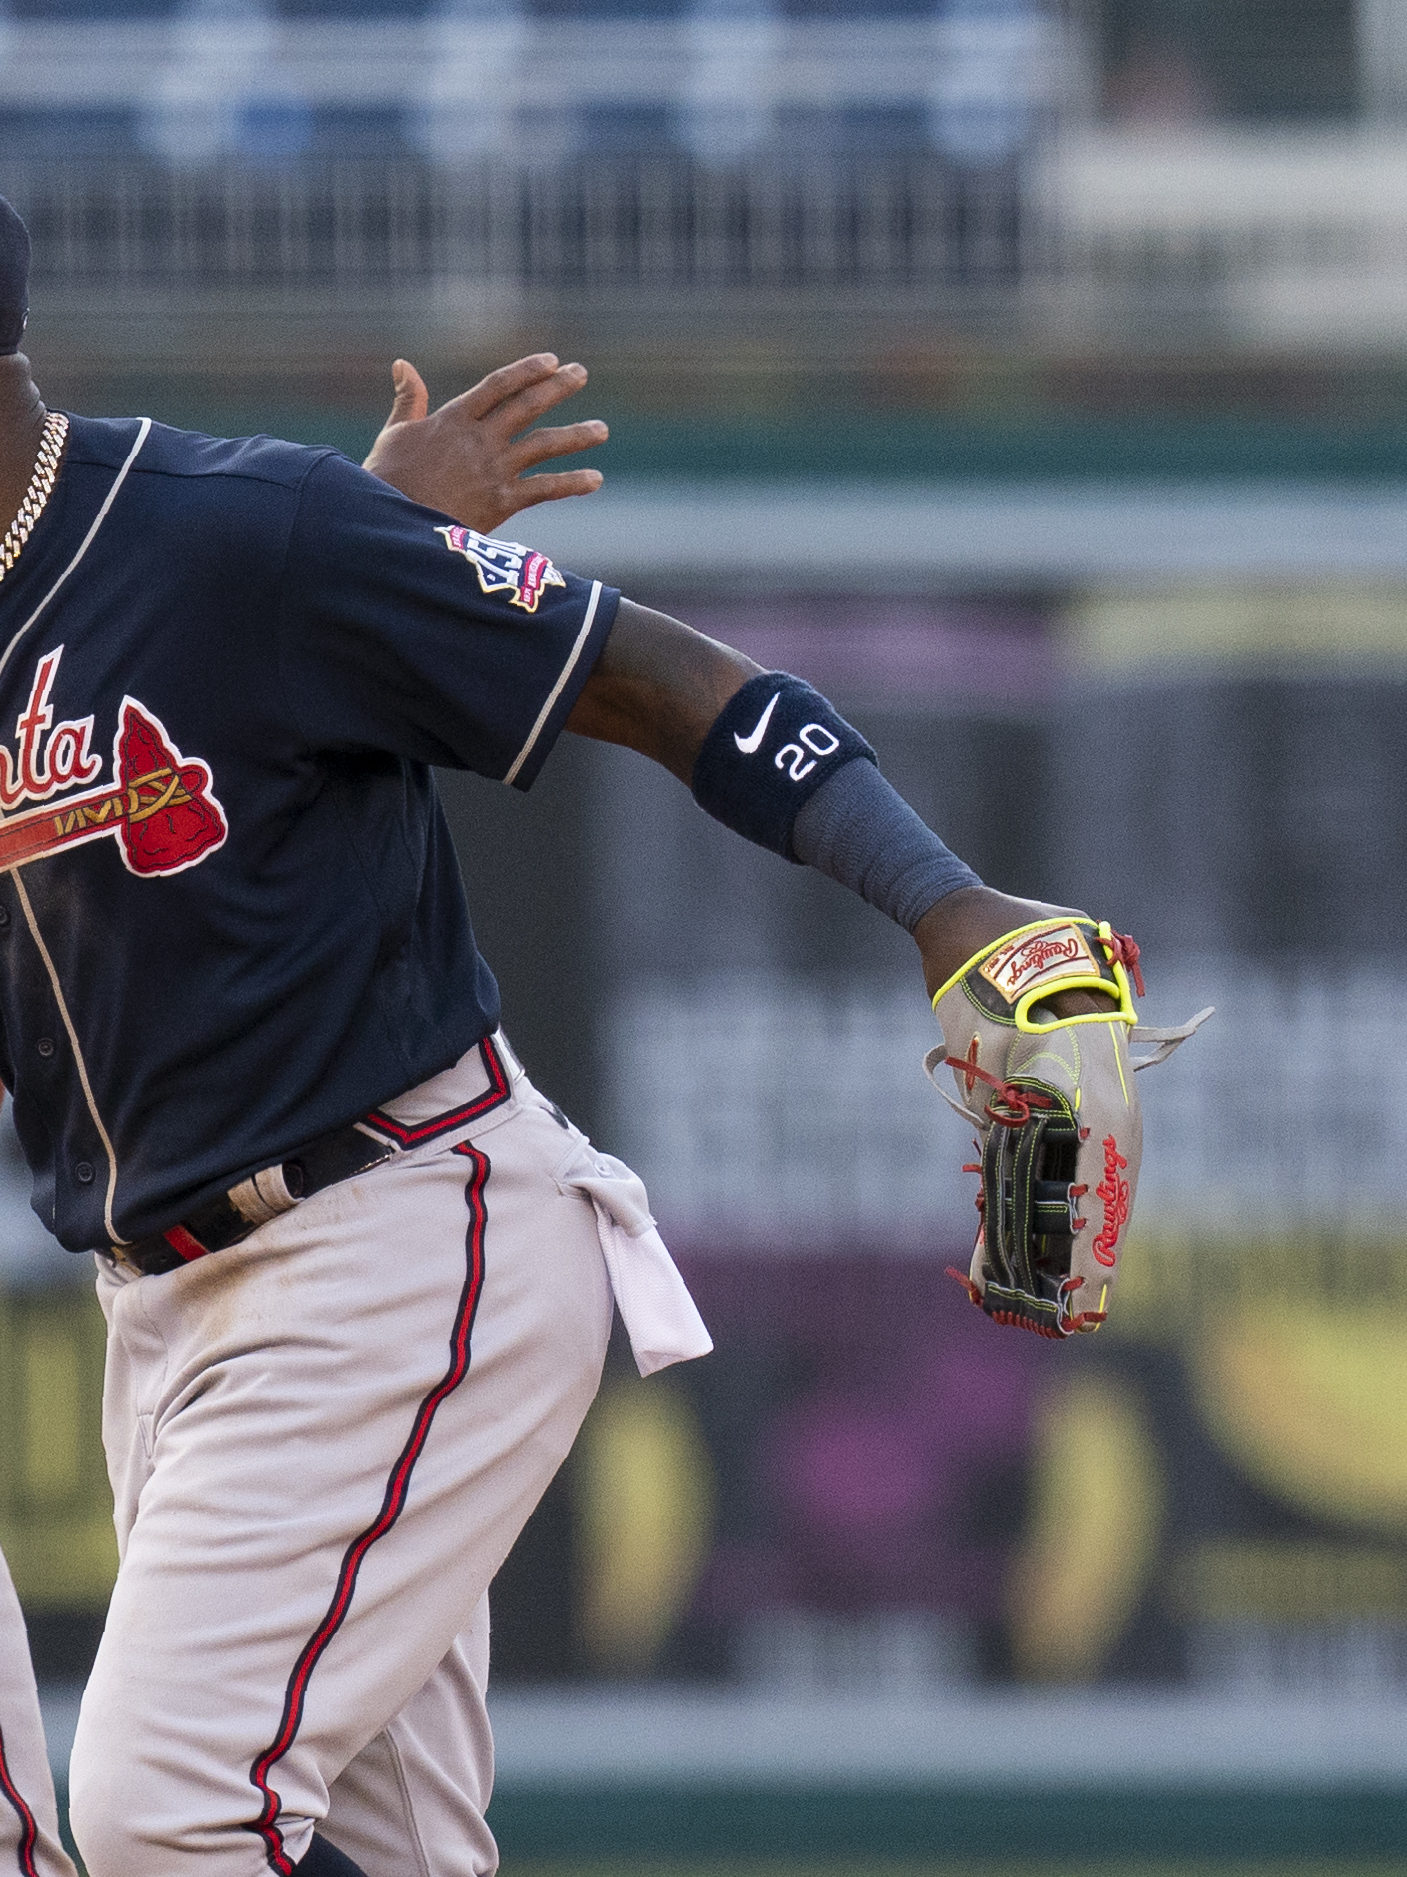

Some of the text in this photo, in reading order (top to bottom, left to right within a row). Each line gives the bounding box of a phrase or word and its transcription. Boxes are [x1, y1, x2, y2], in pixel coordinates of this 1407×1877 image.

[775, 723, 840, 781] 20
[1007, 938, 1079, 987] Rawlings
[1092, 1134, 1128, 1267] Rawlings
